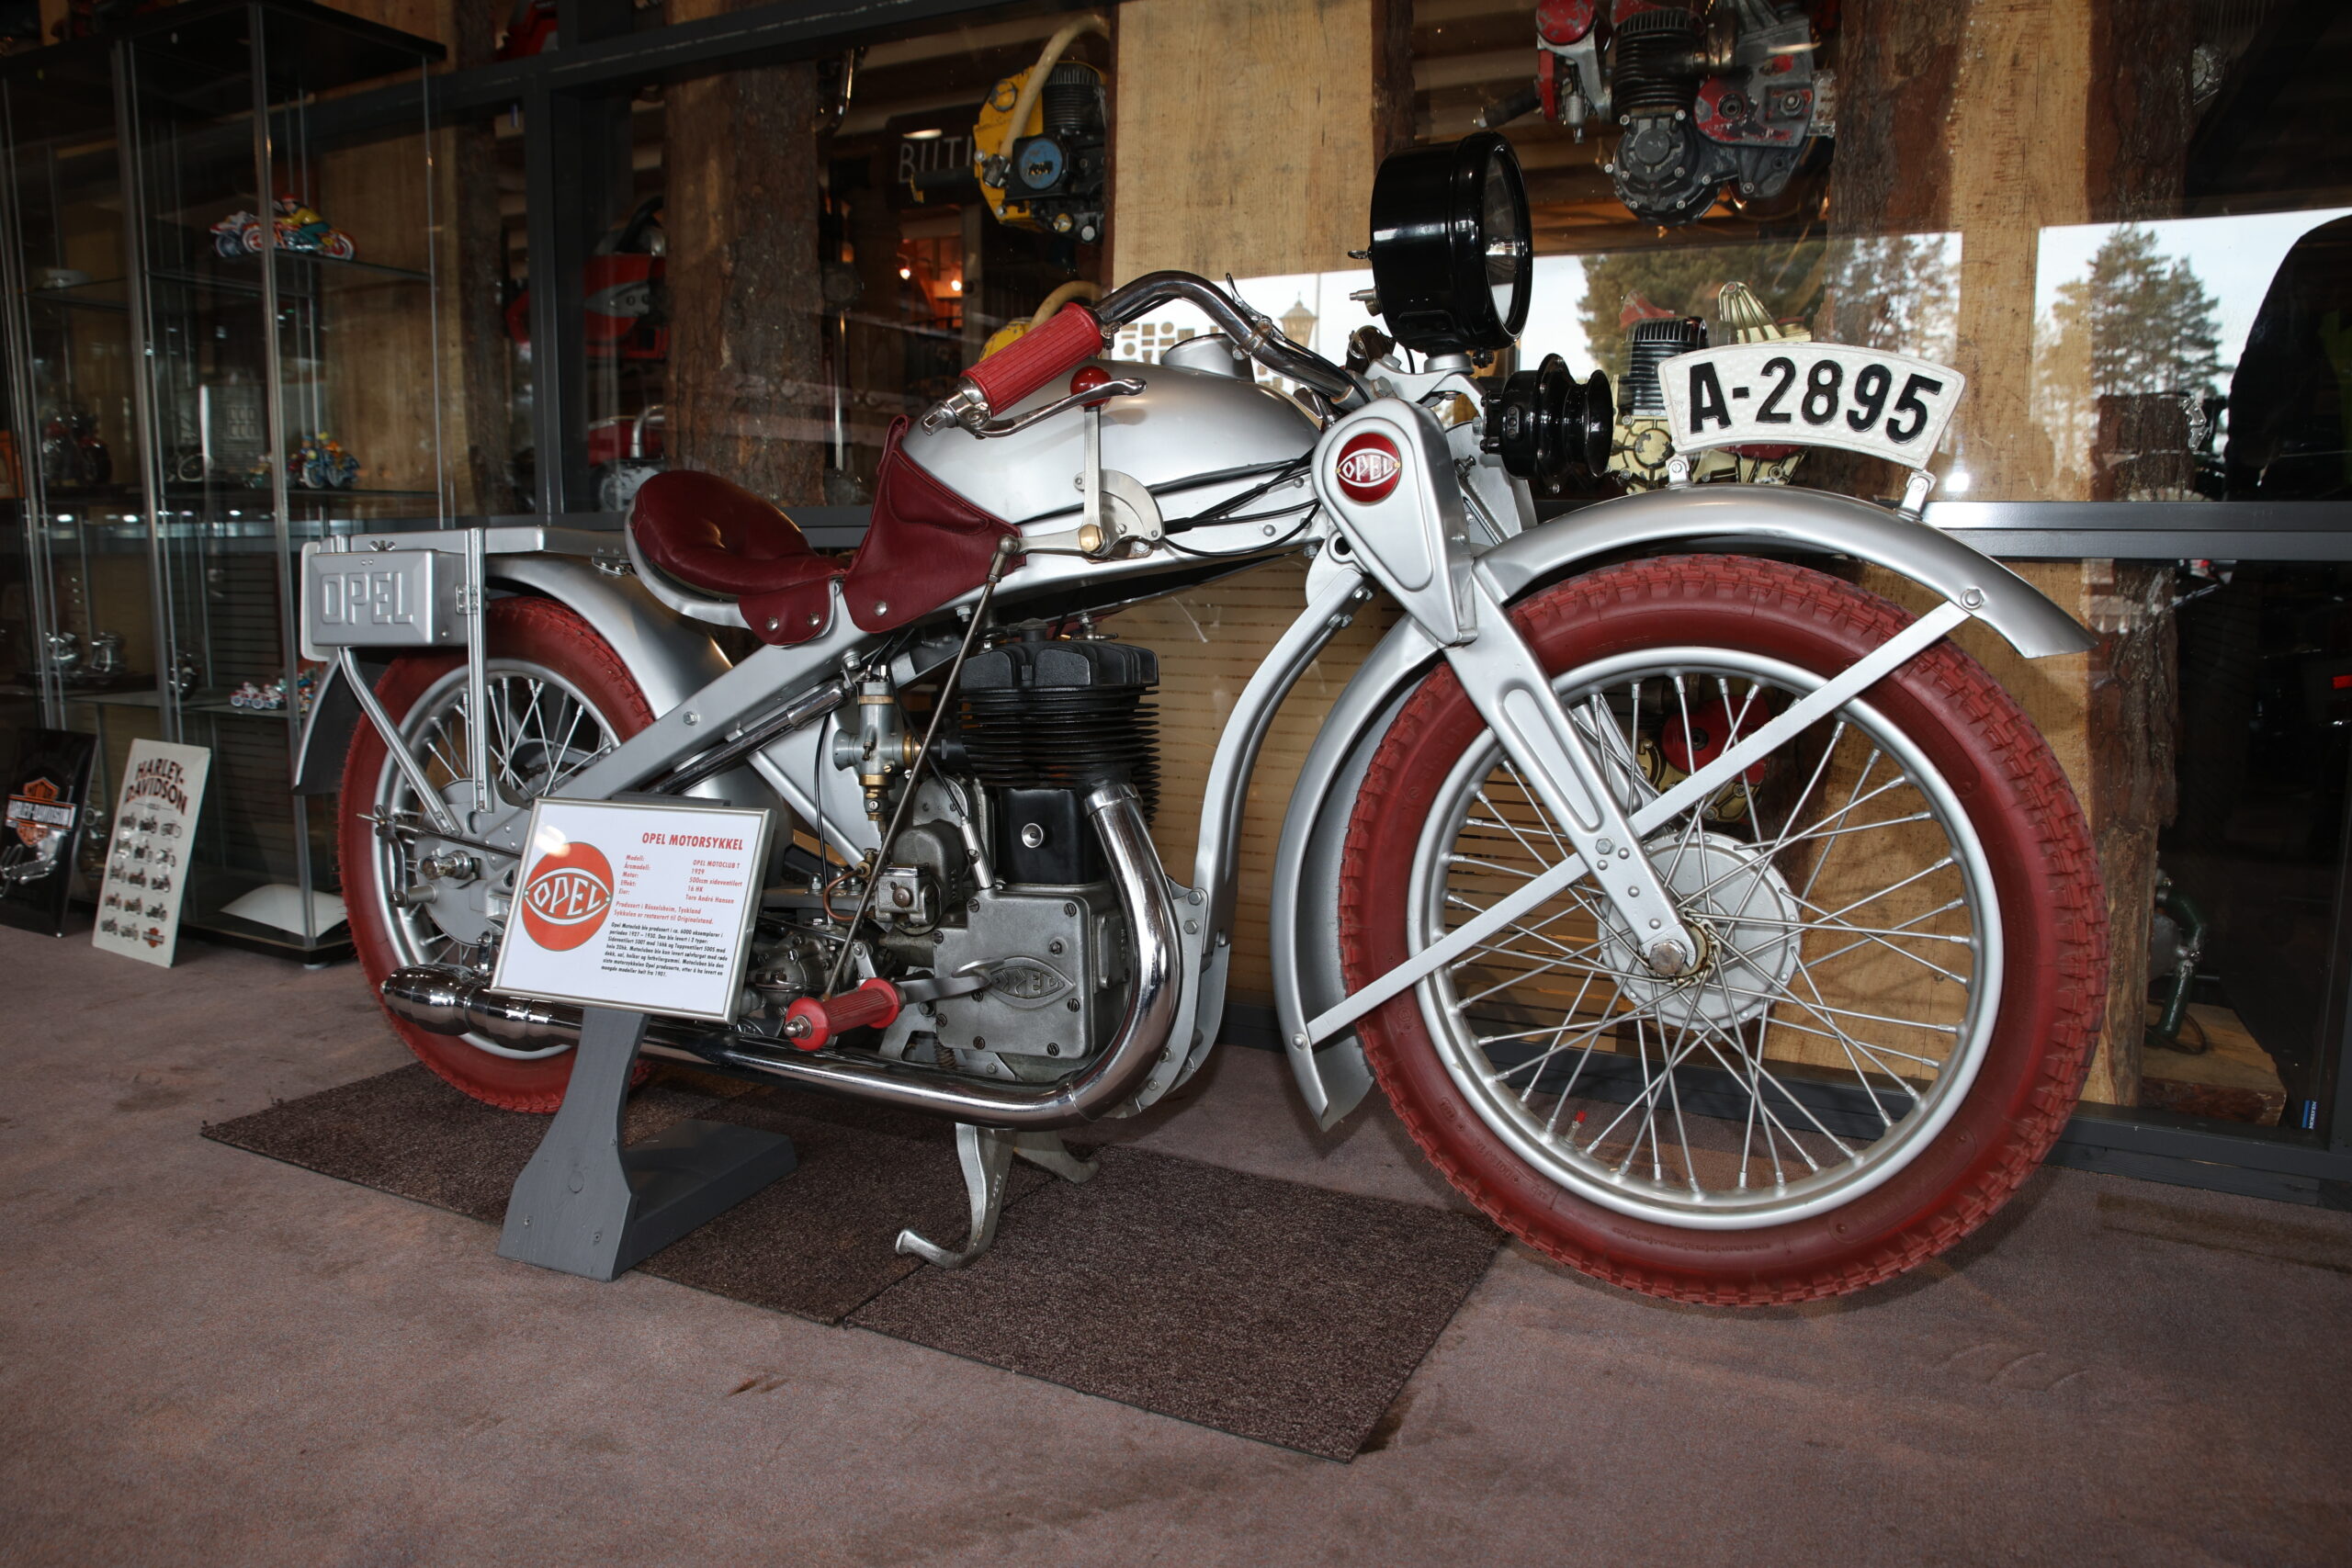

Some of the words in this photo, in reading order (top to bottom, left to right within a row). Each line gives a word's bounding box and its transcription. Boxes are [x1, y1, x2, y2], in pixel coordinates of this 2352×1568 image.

[1690, 356, 1942, 444] A-2895
[1341, 455, 1393, 481] OPEL
[322, 572, 413, 625] OPEL
[135, 759, 185, 784] HARLEY-
[125, 778, 187, 816] DAVIDSON
[642, 832, 666, 844] OPEL
[669, 834, 743, 850] MOTORSYKKEL
[534, 876, 601, 916] OPEL
